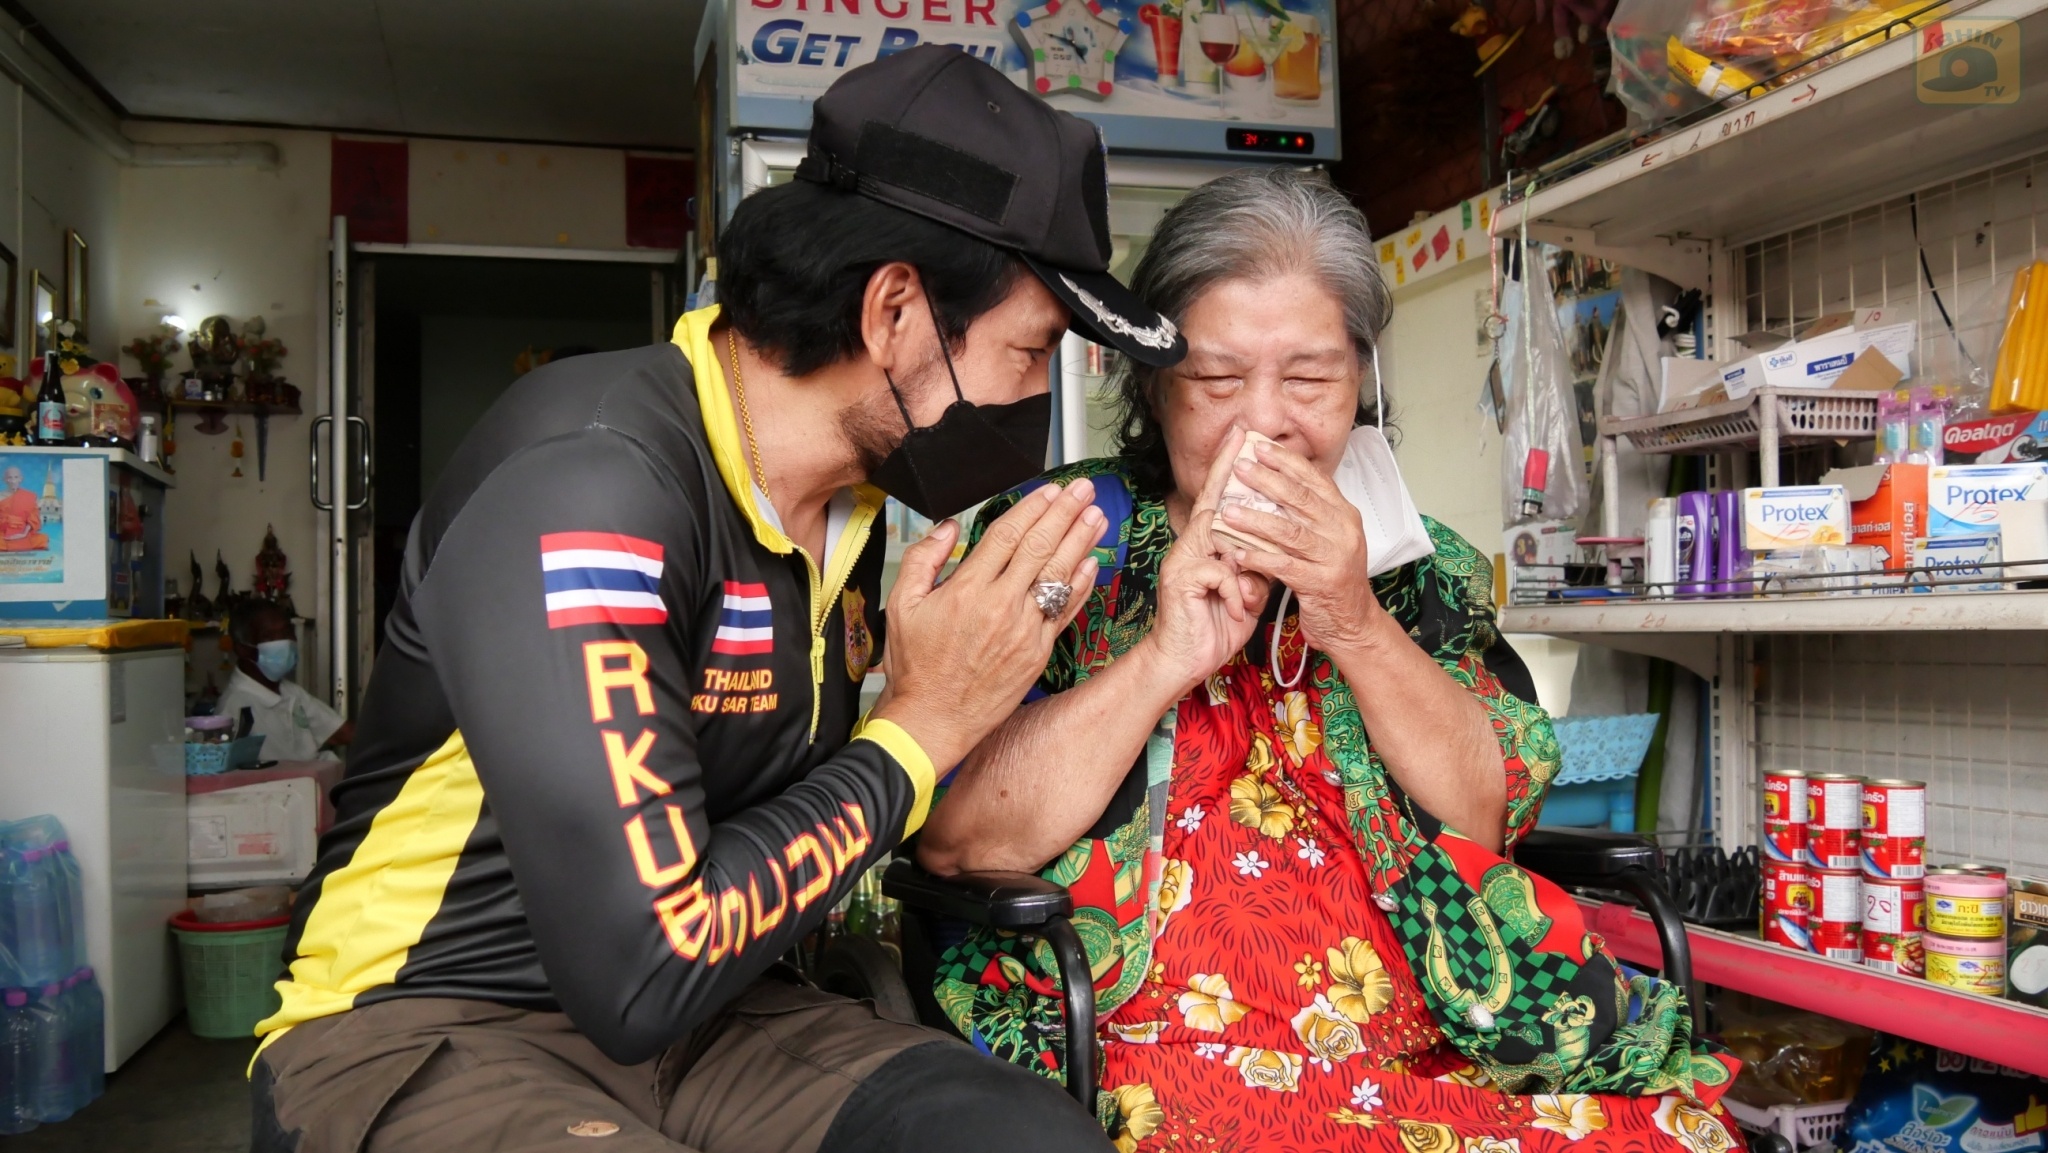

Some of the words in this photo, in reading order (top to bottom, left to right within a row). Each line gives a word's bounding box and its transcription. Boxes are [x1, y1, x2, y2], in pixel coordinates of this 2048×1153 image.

[1947, 484, 2030, 505] Protex
[1762, 503, 1829, 522] Protex
[1925, 555, 1985, 576] Protex
[721, 696, 748, 713] SAR
[750, 693, 778, 712] TEAM
[582, 640, 698, 890] RKU
[653, 802, 872, 966] RSCUE
[1867, 895, 1892, 921] 20
